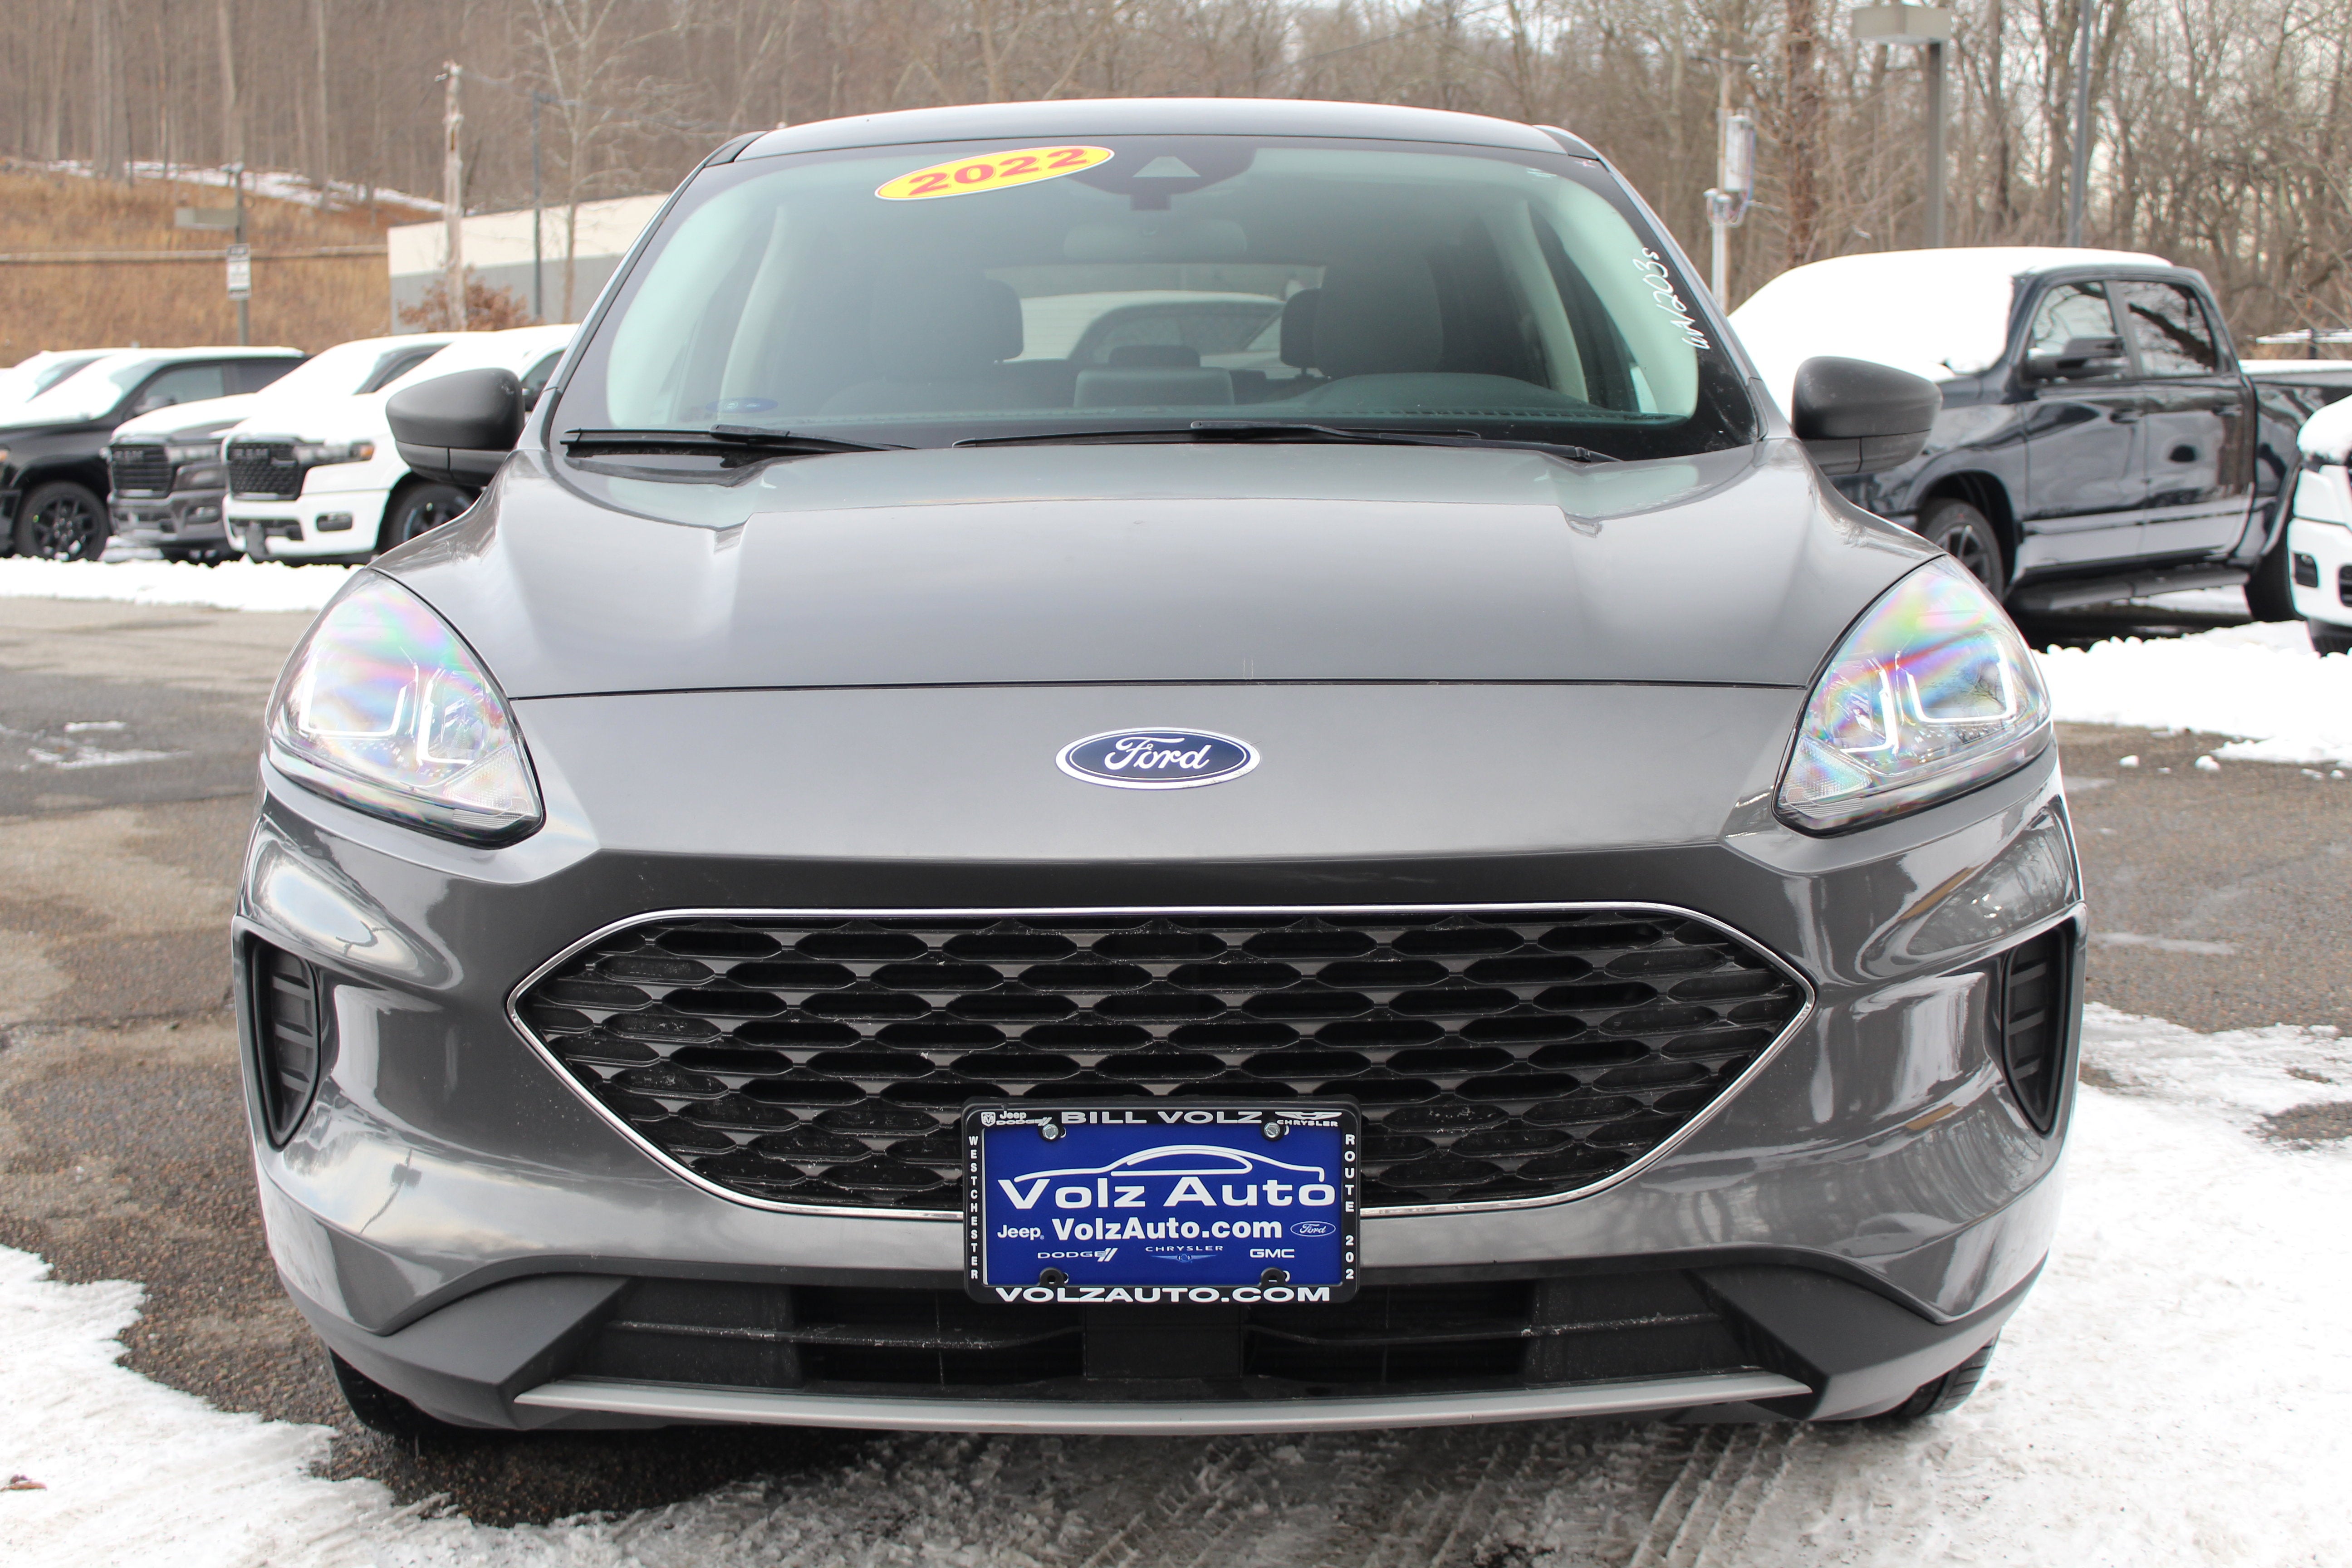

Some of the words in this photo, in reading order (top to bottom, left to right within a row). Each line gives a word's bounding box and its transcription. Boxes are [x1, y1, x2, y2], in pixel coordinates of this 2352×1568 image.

[908, 148, 1090, 196] 2022
[1104, 737, 1212, 770] Ford
[1000, 1110, 1027, 1120] Jeep
[1061, 1112, 1147, 1124] BILL
[1157, 1111, 1262, 1124] VOLZ
[1344, 1134, 1356, 1212] ROUTE
[997, 1177, 1146, 1210] Volz
[1163, 1176, 1336, 1207] Auto
[969, 1136, 978, 1279] WESTCHESTER
[997, 1224, 1041, 1240] Jeep
[1051, 1217, 1283, 1241] VolzAuto.com
[1299, 1223, 1327, 1234] Ford
[1037, 1251, 1107, 1259] DODGE
[1250, 1248, 1295, 1259] GMC
[1345, 1235, 1355, 1279] 202
[995, 1287, 1330, 1303] VOLZAUTO.COM
